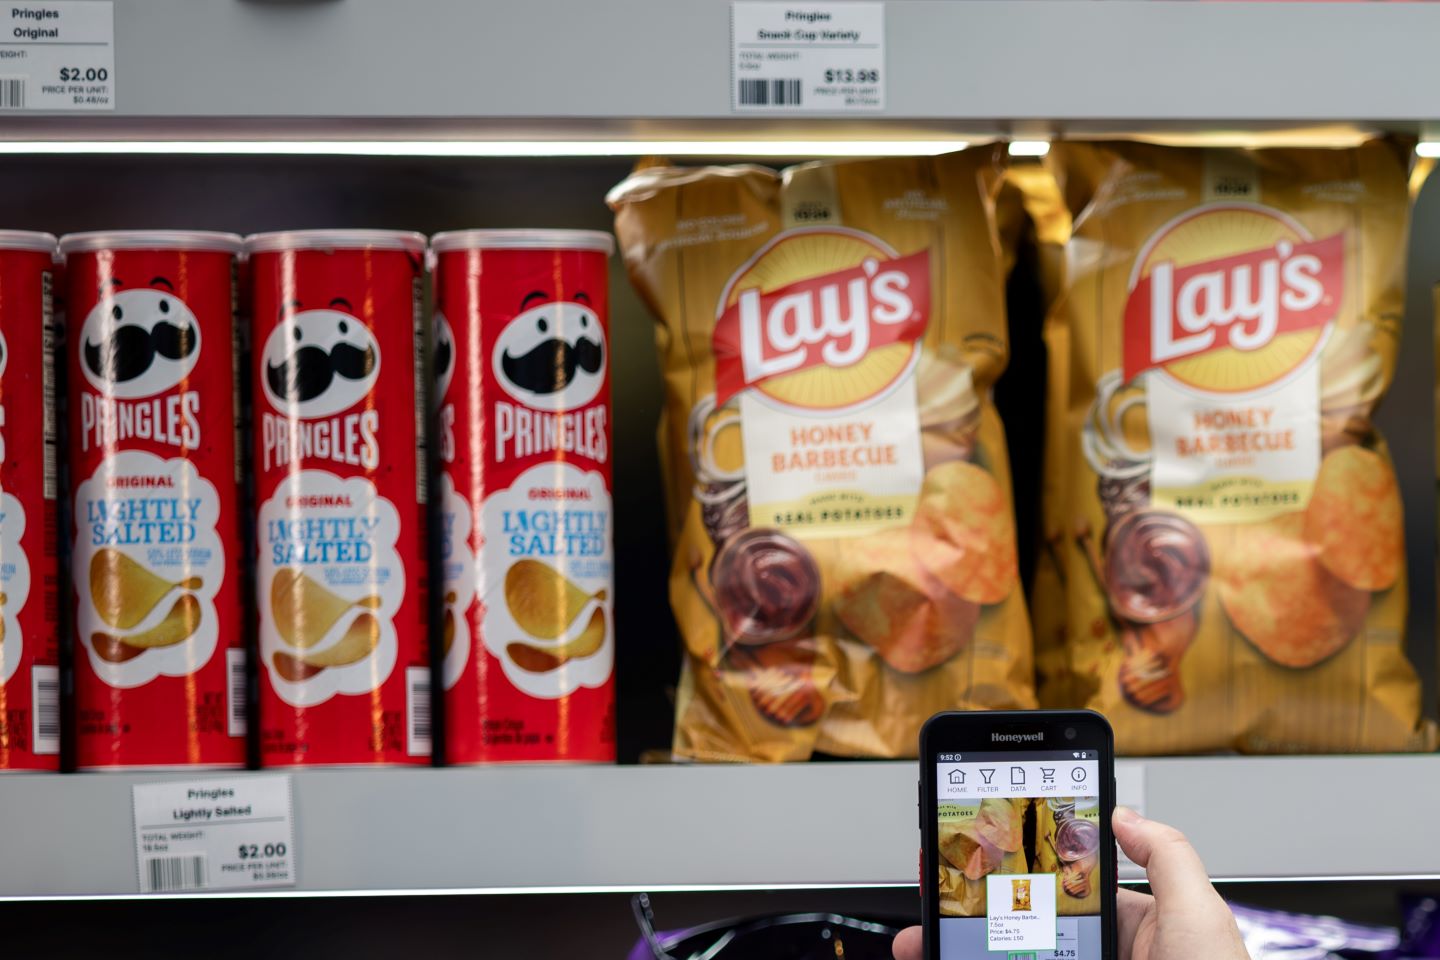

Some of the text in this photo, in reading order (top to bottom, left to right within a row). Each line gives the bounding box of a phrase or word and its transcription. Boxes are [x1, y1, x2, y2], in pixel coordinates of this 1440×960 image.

[12, 8, 59, 20] Pringles
[13, 27, 58, 39] Original
[0, 50, 27, 58] EIGHT:
[60, 67, 108, 81] $2.00
[42, 86, 107, 94] PRICE PER UNIT:
[1150, 239, 1324, 363] Lay's
[738, 257, 913, 384] Lay's
[81, 391, 200, 452] PRINGLES
[1194, 407, 1273, 429] HONEY
[263, 409, 379, 472] PRINGLES
[495, 400, 607, 464] PRINGLES
[790, 422, 874, 446] HONEY
[1175, 430, 1294, 457] BARBECUE
[771, 445, 897, 473] BARBECUE
[108, 475, 174, 489] ORIGINAL
[528, 486, 591, 500] ORIGINAL
[88, 497, 201, 523] LIGHTLY
[774, 507, 904, 525] REAL POTATOES
[92, 521, 196, 546] SALTED
[268, 516, 380, 543] LIGHTLY
[503, 510, 608, 535] LIGHTLY
[272, 540, 373, 566] SALTED
[509, 534, 605, 557] SALTED
[991, 732, 1044, 743] Honeywell
[188, 788, 234, 800] Pringles
[173, 805, 252, 821] Lightly Salted
[238, 842, 287, 859] $2.00
